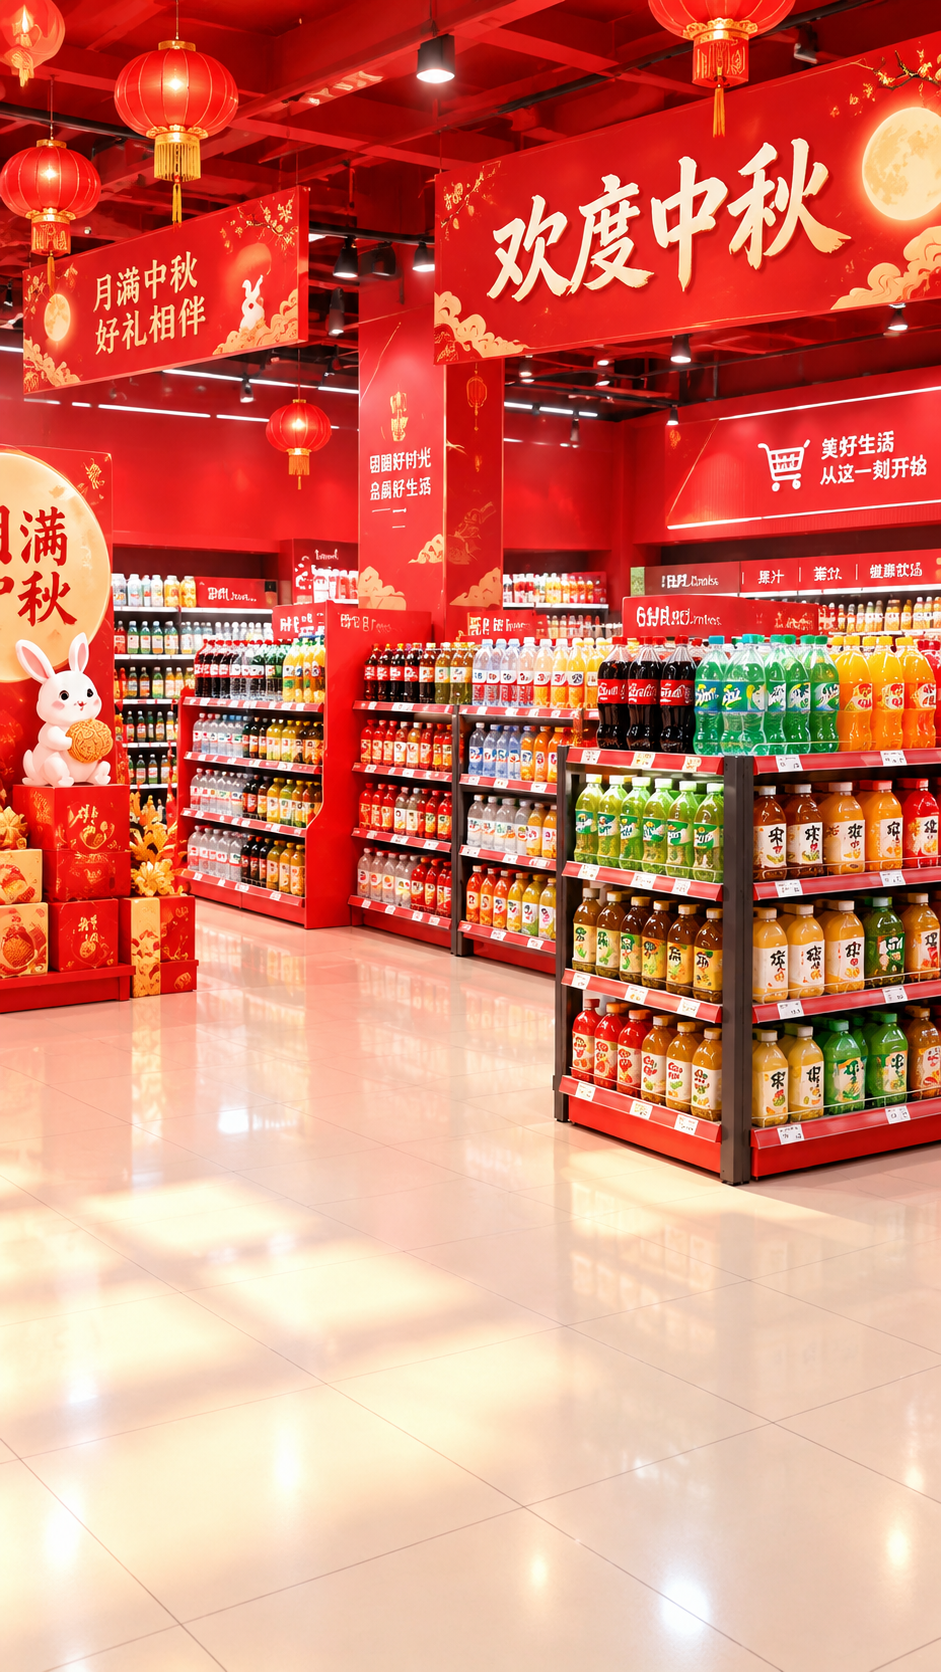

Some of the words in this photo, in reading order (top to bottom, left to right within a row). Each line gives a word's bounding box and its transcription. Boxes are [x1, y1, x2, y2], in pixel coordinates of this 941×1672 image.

[487, 138, 852, 301] 欢度中秋
[93, 251, 198, 313] 月满中秋
[95, 295, 206, 355] 好礼相伴
